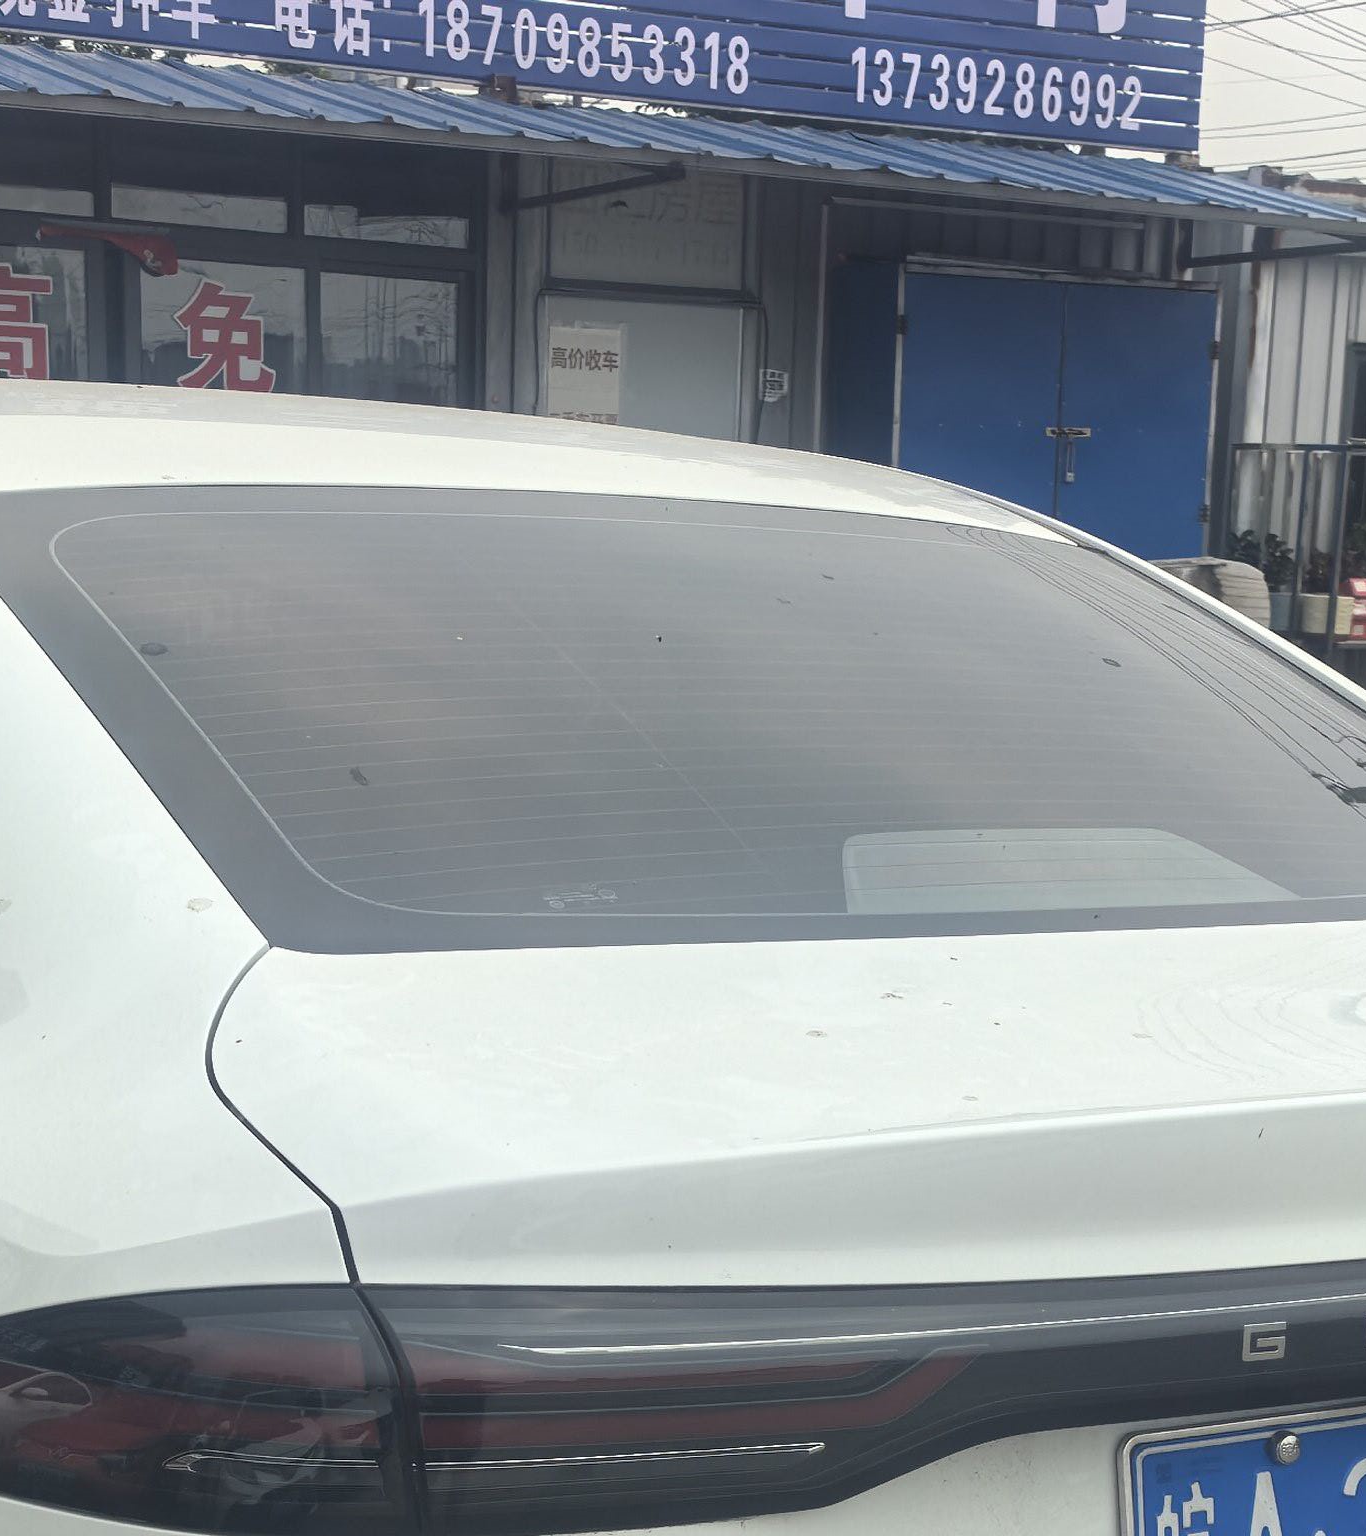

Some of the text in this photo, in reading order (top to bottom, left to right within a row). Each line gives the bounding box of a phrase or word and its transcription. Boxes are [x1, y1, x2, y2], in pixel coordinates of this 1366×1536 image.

[419, 0, 750, 94] 18709853318
[851, 46, 1141, 131] 13739286992
[550, 347, 620, 373] 高价收车
